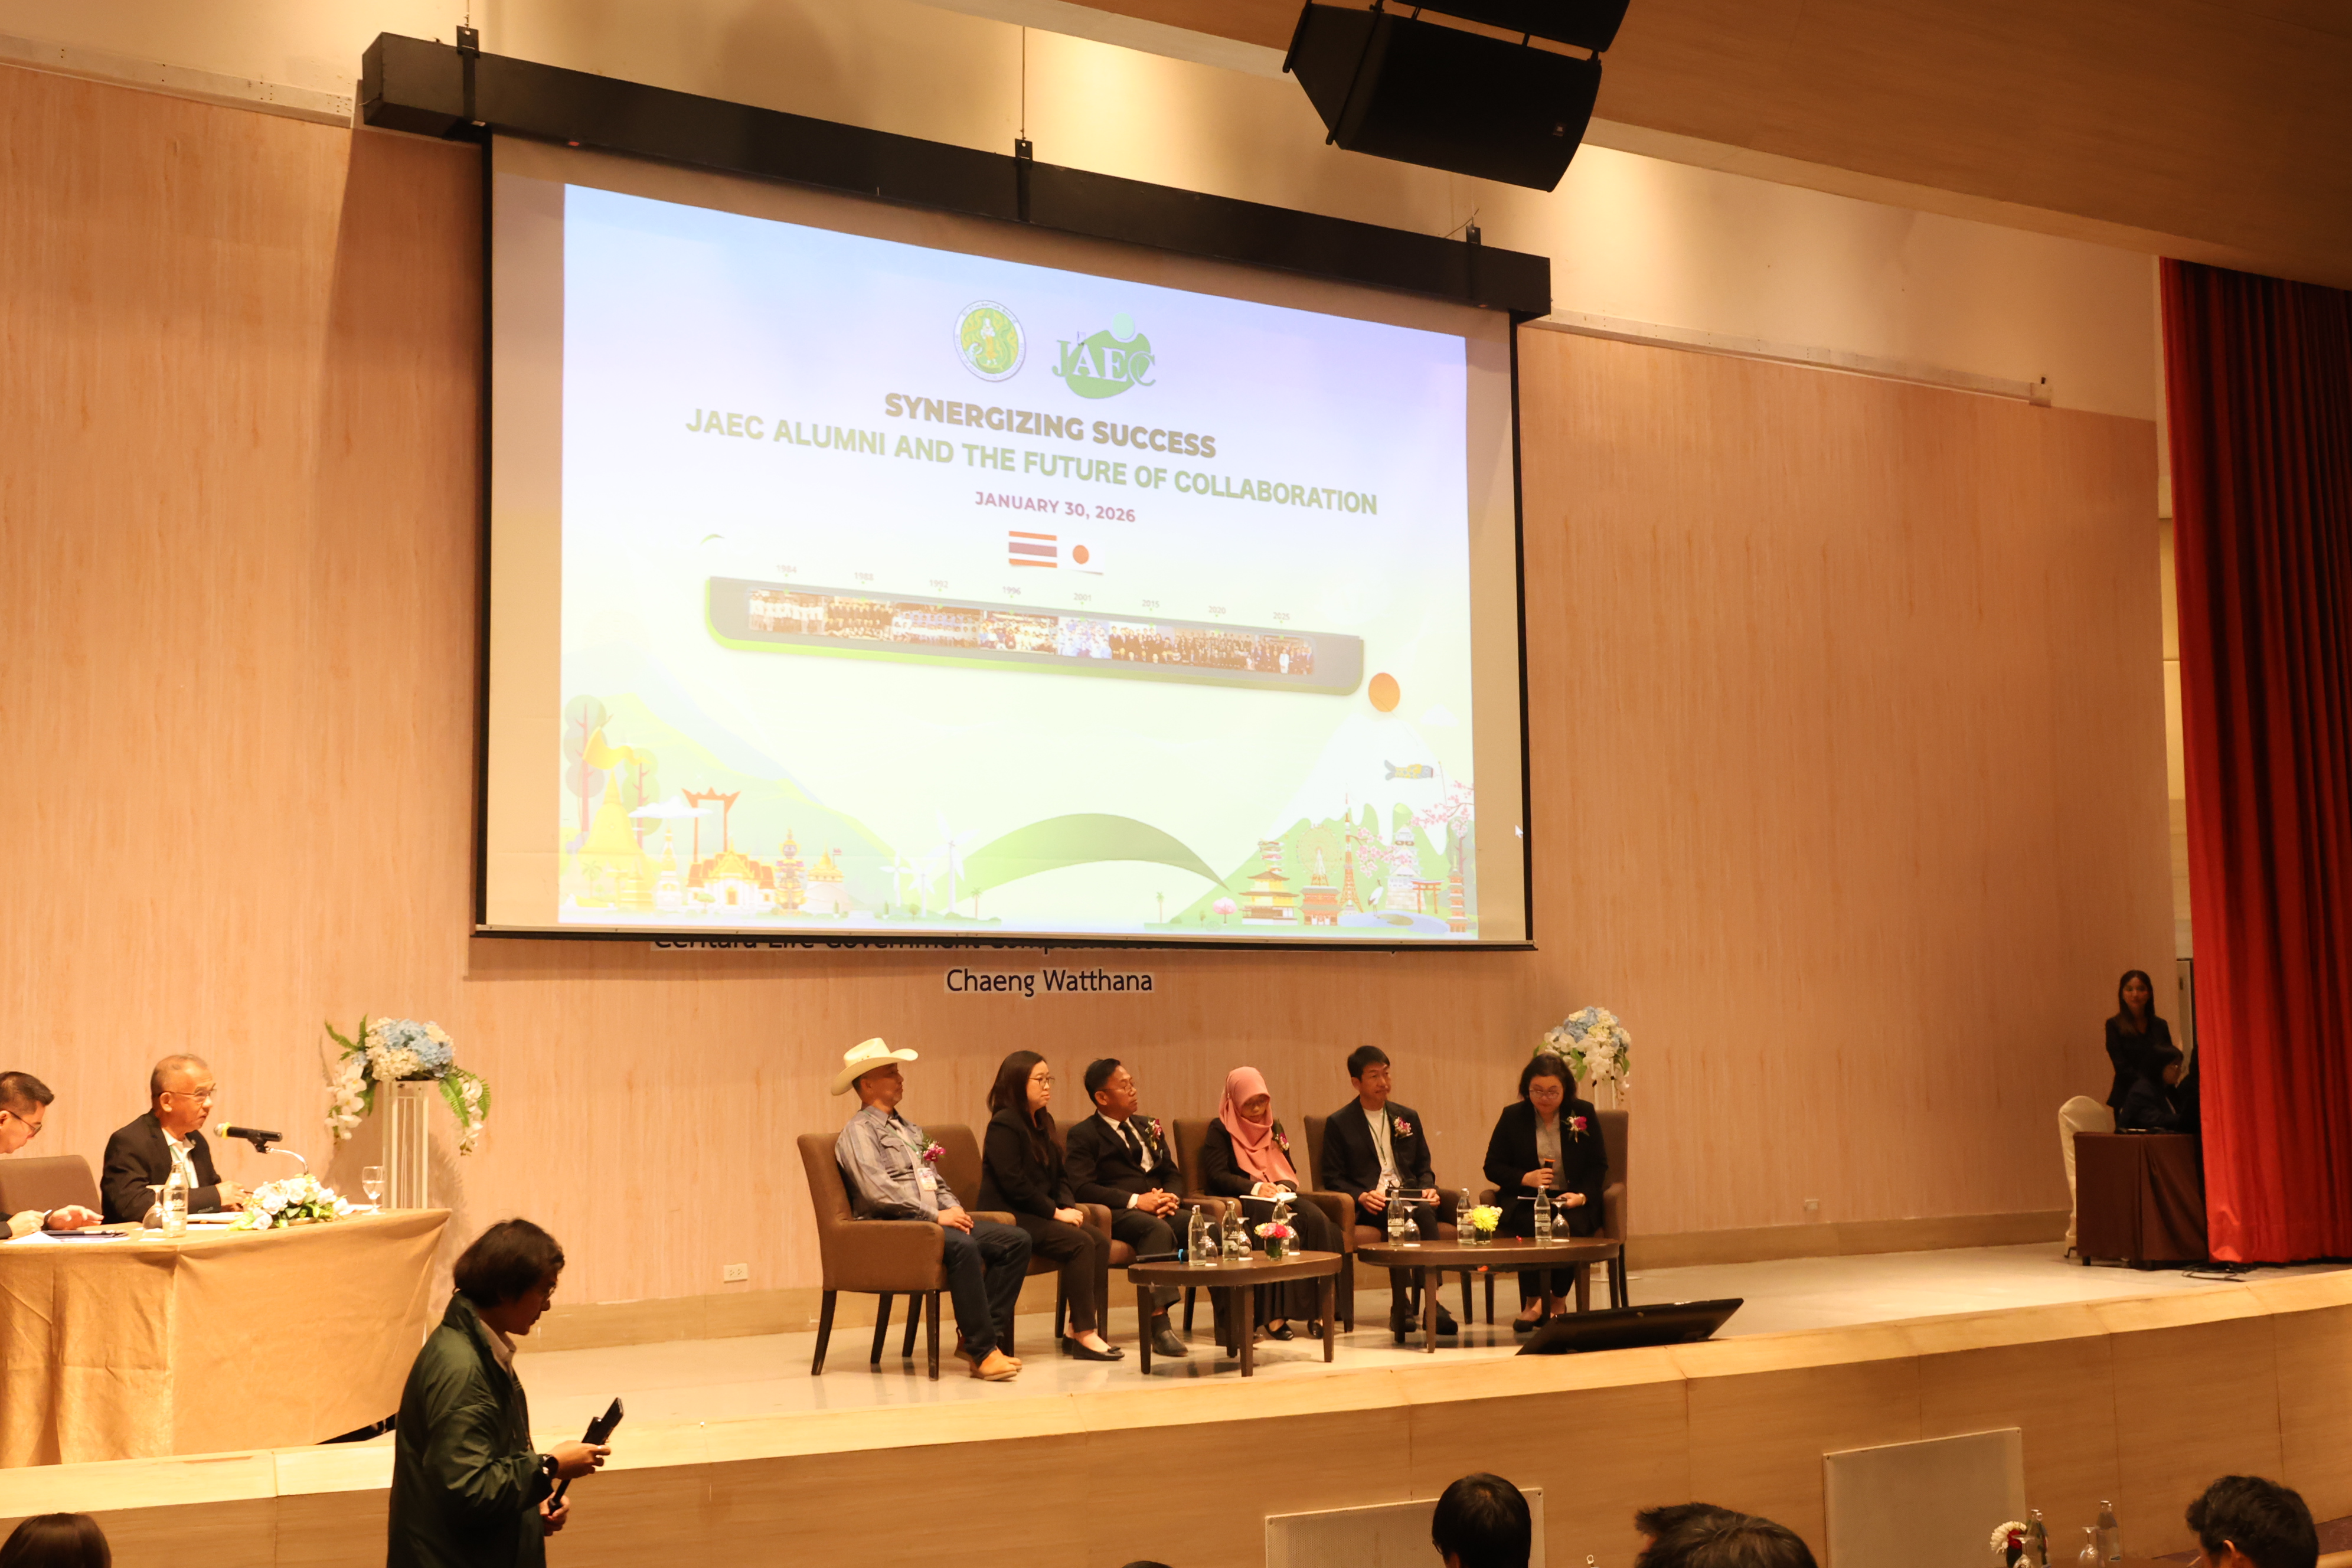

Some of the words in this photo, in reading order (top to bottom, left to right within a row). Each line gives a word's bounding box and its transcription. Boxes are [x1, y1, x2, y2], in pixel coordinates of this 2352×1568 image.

[1051, 339, 1157, 387] JAEC
[885, 393, 1084, 441] SYNERGIZING
[1092, 421, 1217, 459] SUCCESS
[685, 408, 765, 439] JAEC
[773, 419, 886, 455] ALUMNI
[894, 435, 954, 463] AND
[962, 443, 1015, 472] THE
[1024, 451, 1128, 486] FUTURE
[1134, 465, 1168, 489] OF
[1174, 471, 1378, 515] COLLABORATION
[975, 491, 1060, 514] JANUARY
[1064, 503, 1090, 520] 30,
[1095, 505, 1136, 523] 2026
[1002, 586, 1022, 596] 1996
[1073, 592, 1092, 602] 2001
[1141, 599, 1160, 608] 2015
[1208, 606, 1227, 615] 2020
[1272, 612, 1291, 621] 2025
[946, 968, 1035, 998] Chaeng
[1043, 968, 1153, 991] Watthana
